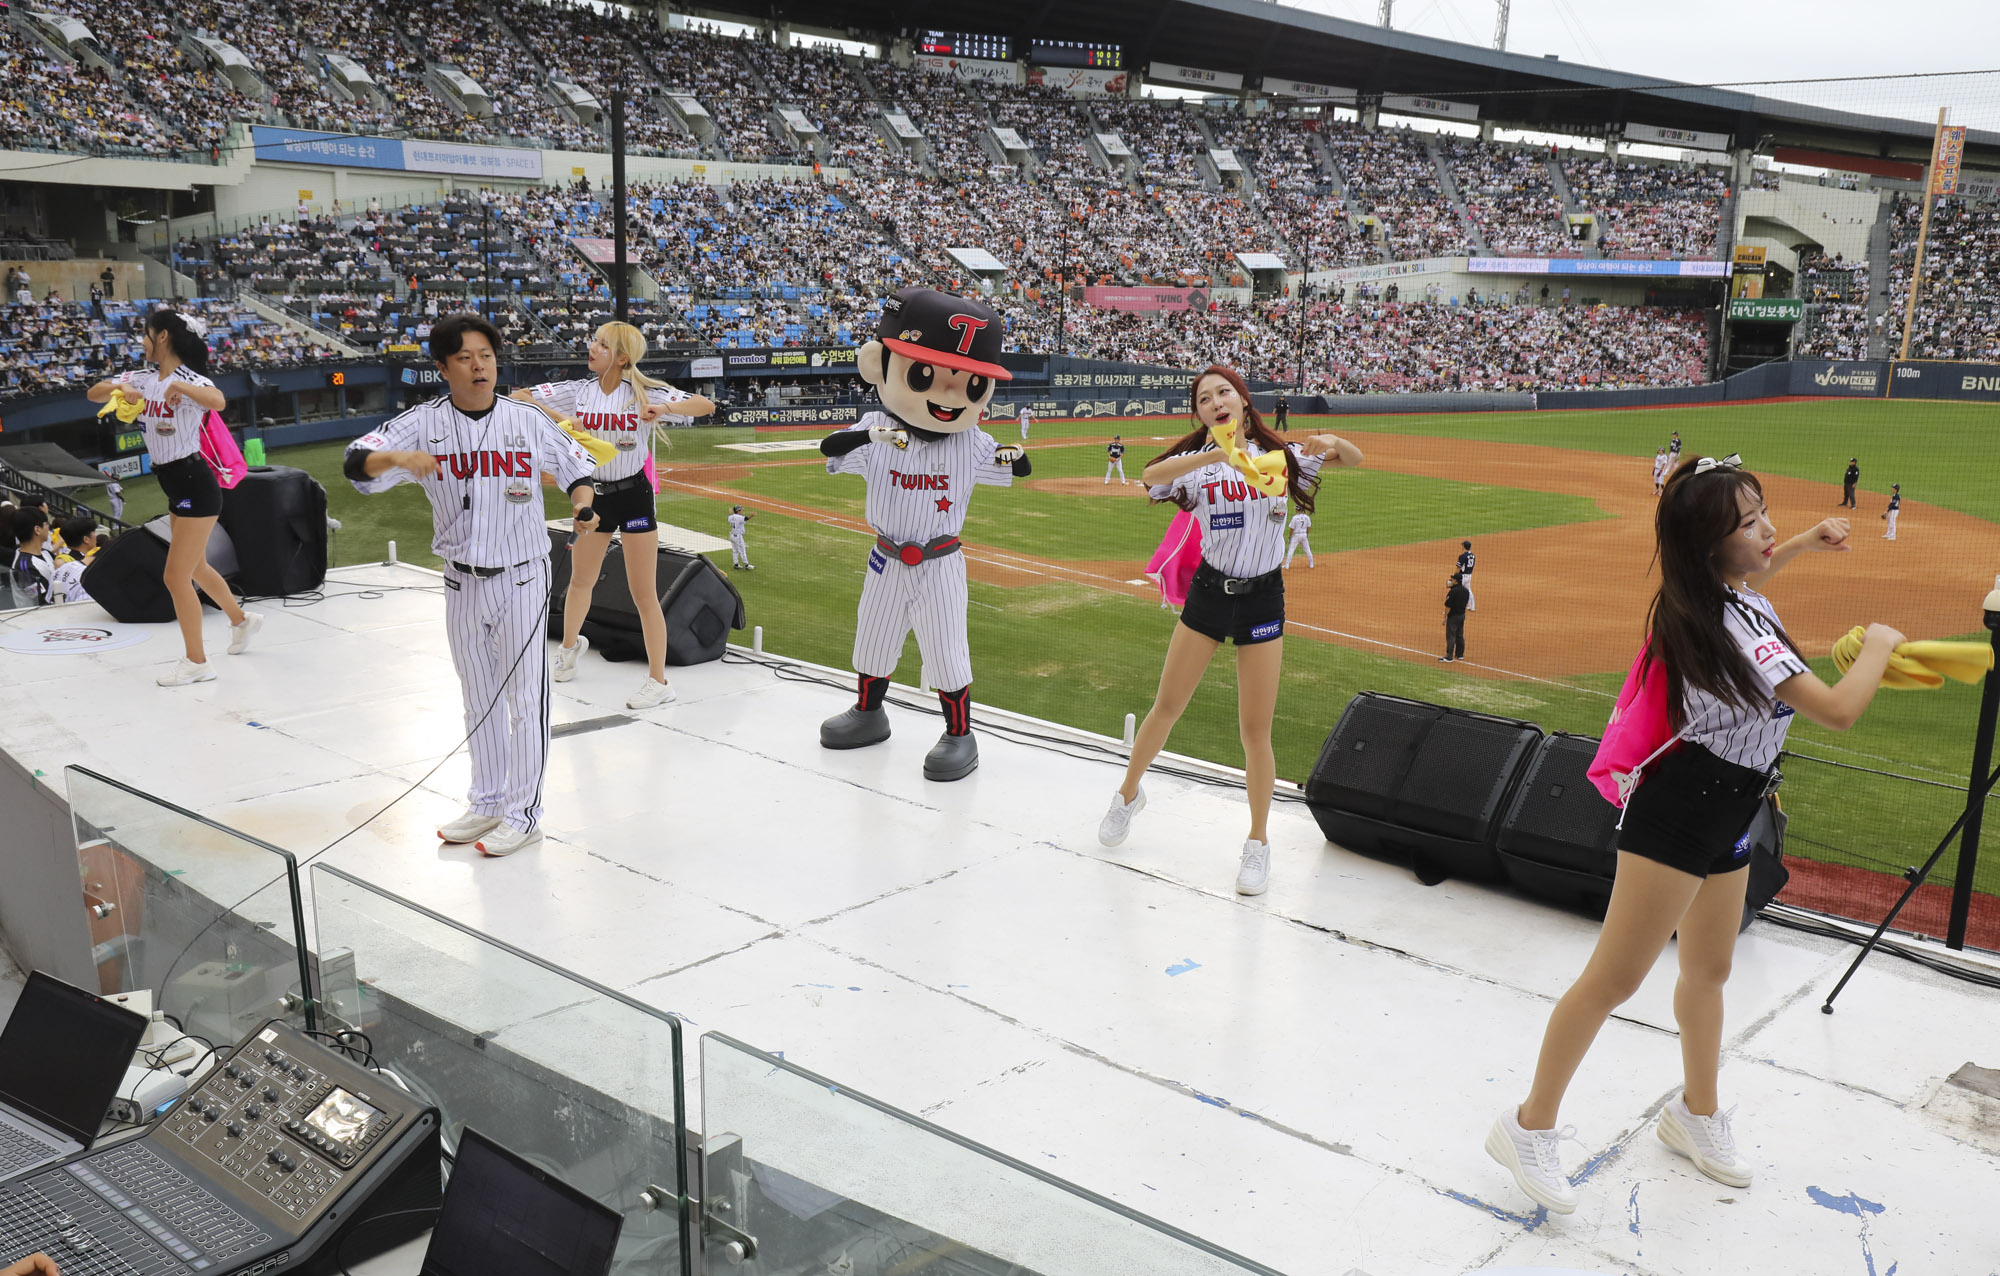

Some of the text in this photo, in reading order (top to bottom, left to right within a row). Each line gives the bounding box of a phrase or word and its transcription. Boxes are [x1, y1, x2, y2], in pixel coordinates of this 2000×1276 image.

[339, 144, 356, 157] 되는
[358, 146, 376, 159] 순간
[506, 157, 531, 170] SPACE
[1638, 263, 1653, 272] 순간
[1155, 294, 1183, 304] TVING
[1732, 305, 1800, 318] 대신정보통신
[949, 314, 988, 355] T
[730, 354, 767, 365] mentos
[820, 350, 854, 363] 수협보험
[332, 372, 345, 386] 20
[420, 370, 442, 383] IBK
[1054, 374, 1091, 386] 공공기관
[1095, 374, 1135, 386] 이사가자!
[1896, 368, 1920, 381] 100m
[1095, 403, 1116, 415] PRINGLES
[1145, 401, 1166, 414] PRINGLES
[742, 410, 768, 423] 금강주택
[779, 409, 817, 422] 금강펜테리움
[832, 408, 856, 421] 금강주택
[504, 434, 525, 448] LG
[111, 459, 139, 475] 에이스침대
[890, 469, 949, 490] TWINS
